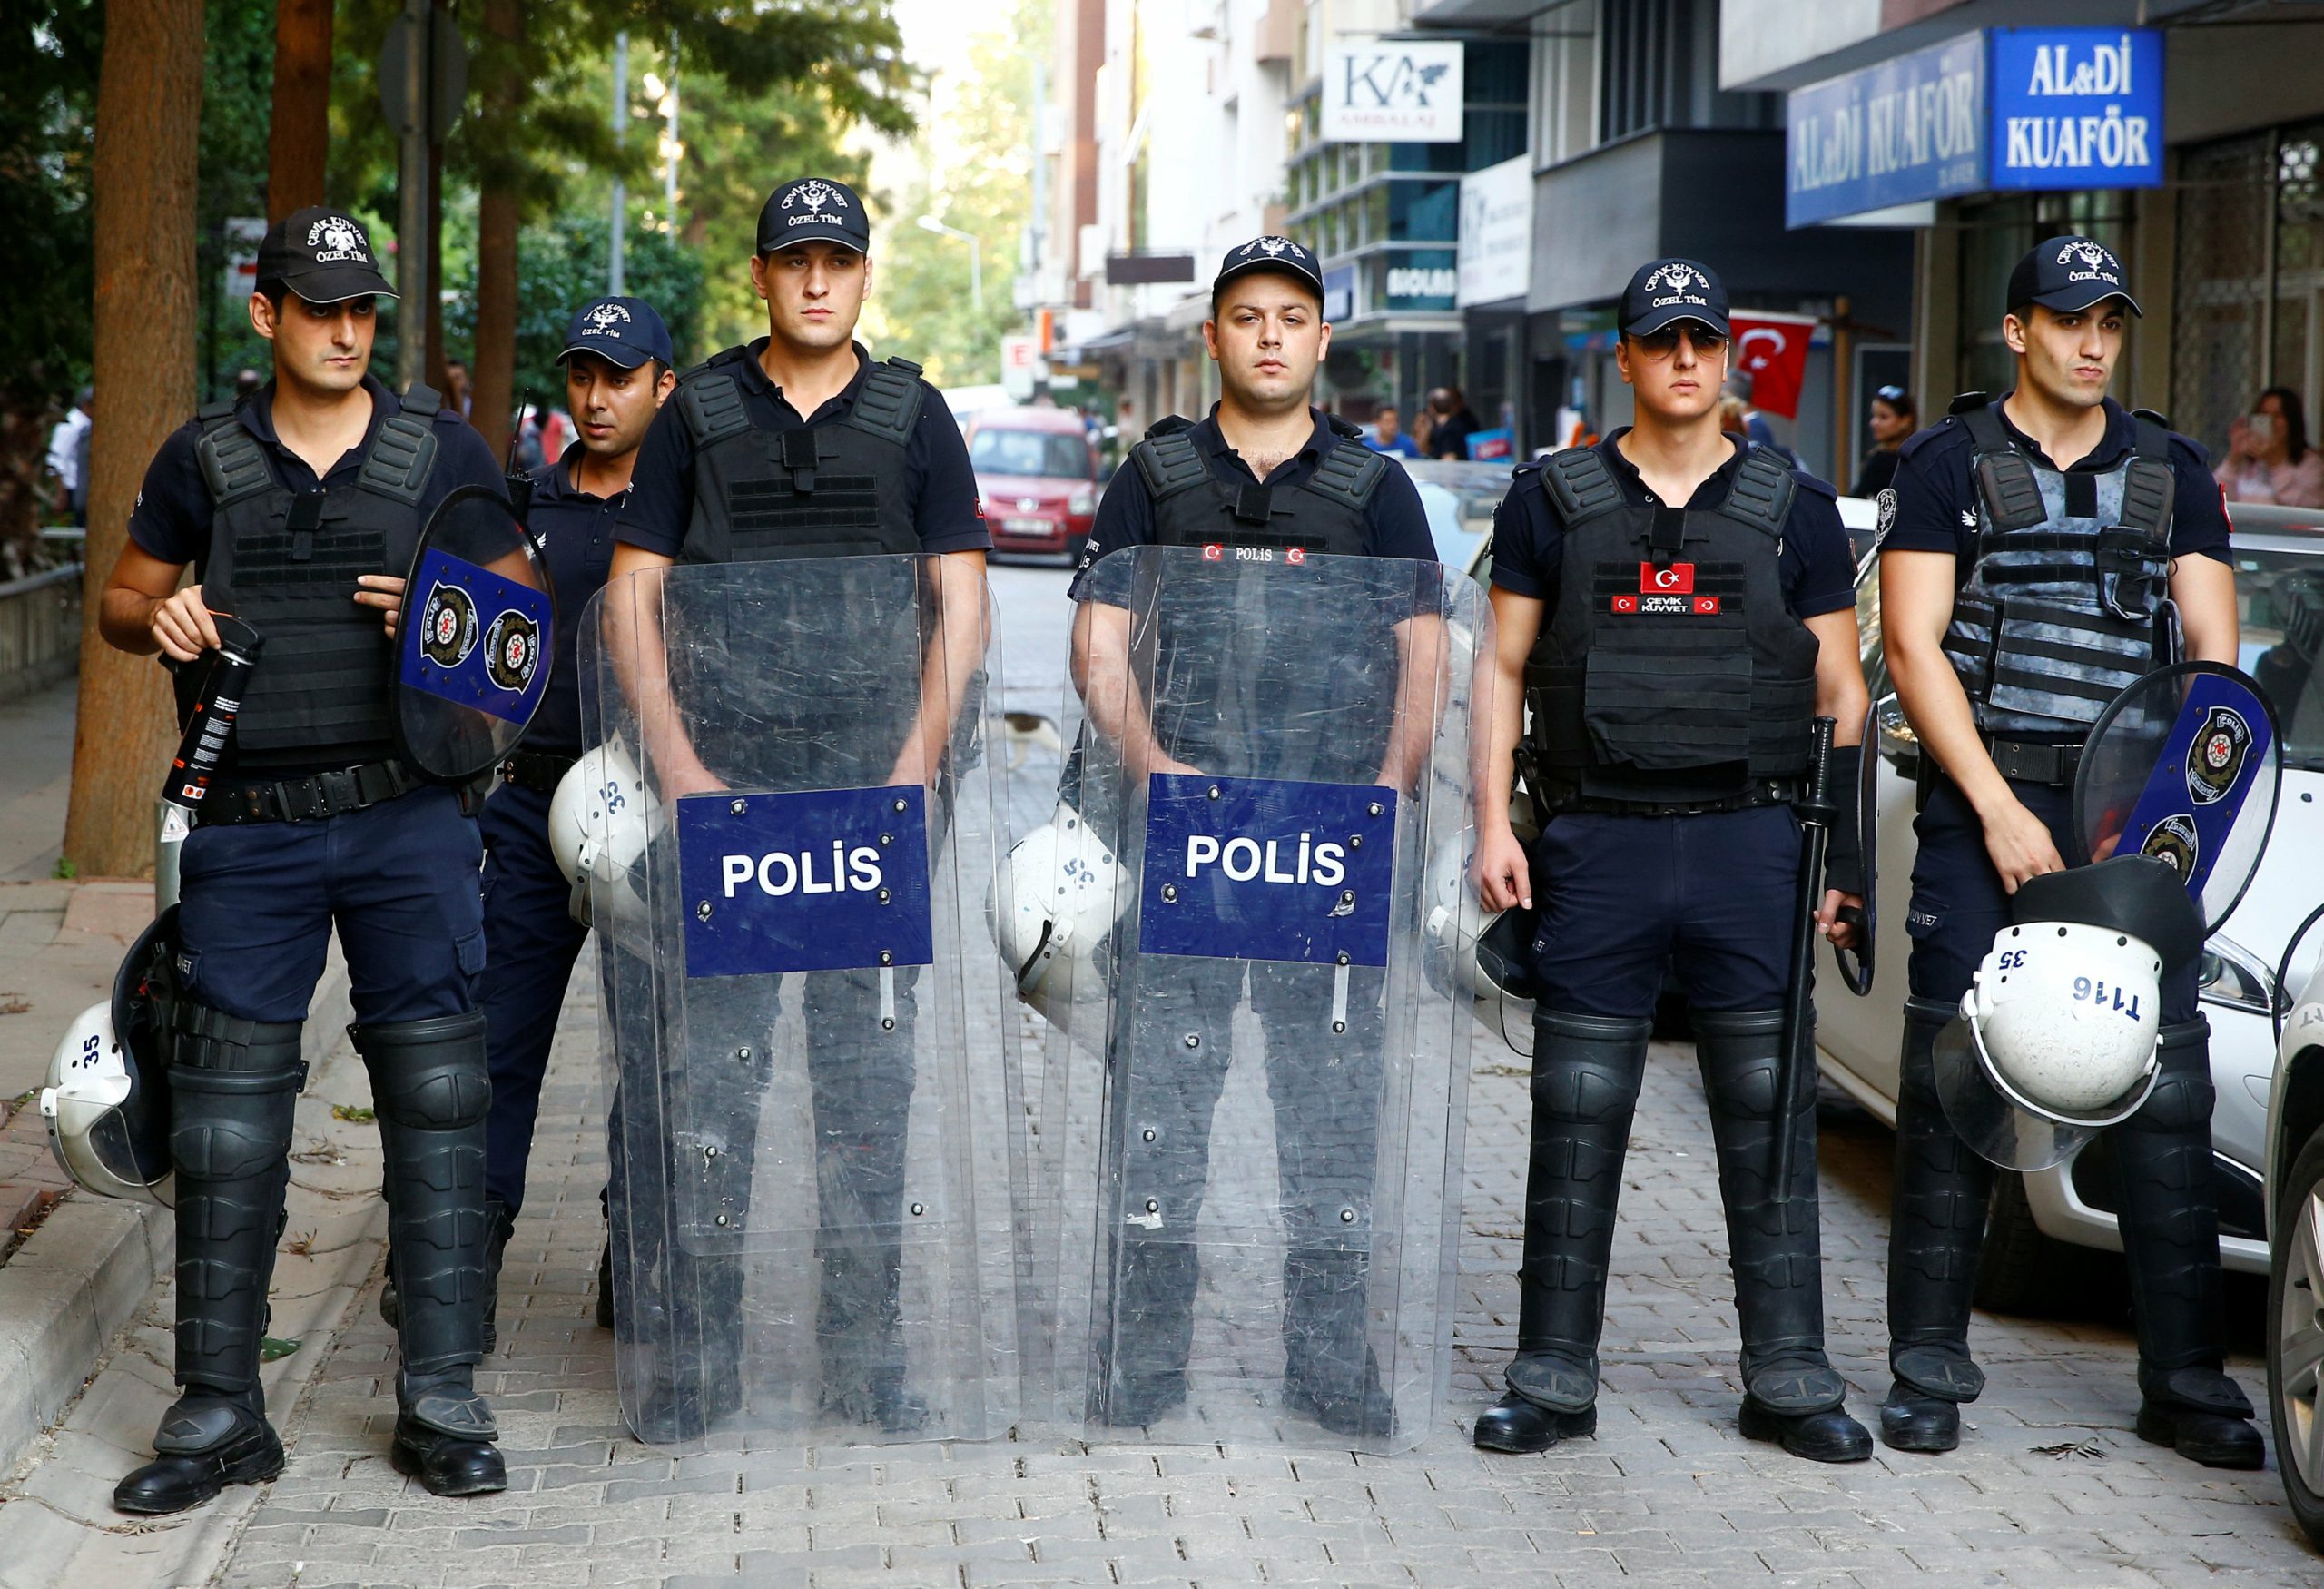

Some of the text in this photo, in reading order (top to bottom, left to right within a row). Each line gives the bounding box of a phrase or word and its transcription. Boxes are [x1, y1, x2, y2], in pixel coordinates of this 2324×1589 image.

[2027, 33, 2132, 97] AL&Dİ
[1866, 55, 1976, 176] KUAFÖR
[2006, 104, 2151, 169] KUAFÖR
[788, 212, 843, 227] ÖZEL TİM
[315, 250, 350, 263] ÖZEL
[2068, 271, 2102, 282] ÖZEL
[1652, 294, 1708, 308] ÖZEL TİM
[1641, 604, 1689, 613] KUVVET
[599, 781, 625, 815] 35
[722, 839, 882, 898] POLİS
[1186, 832, 1345, 887] POLİS
[1998, 950, 2027, 970] 35
[2073, 976, 2141, 1022] T116
[84, 1034, 100, 1069] 35
